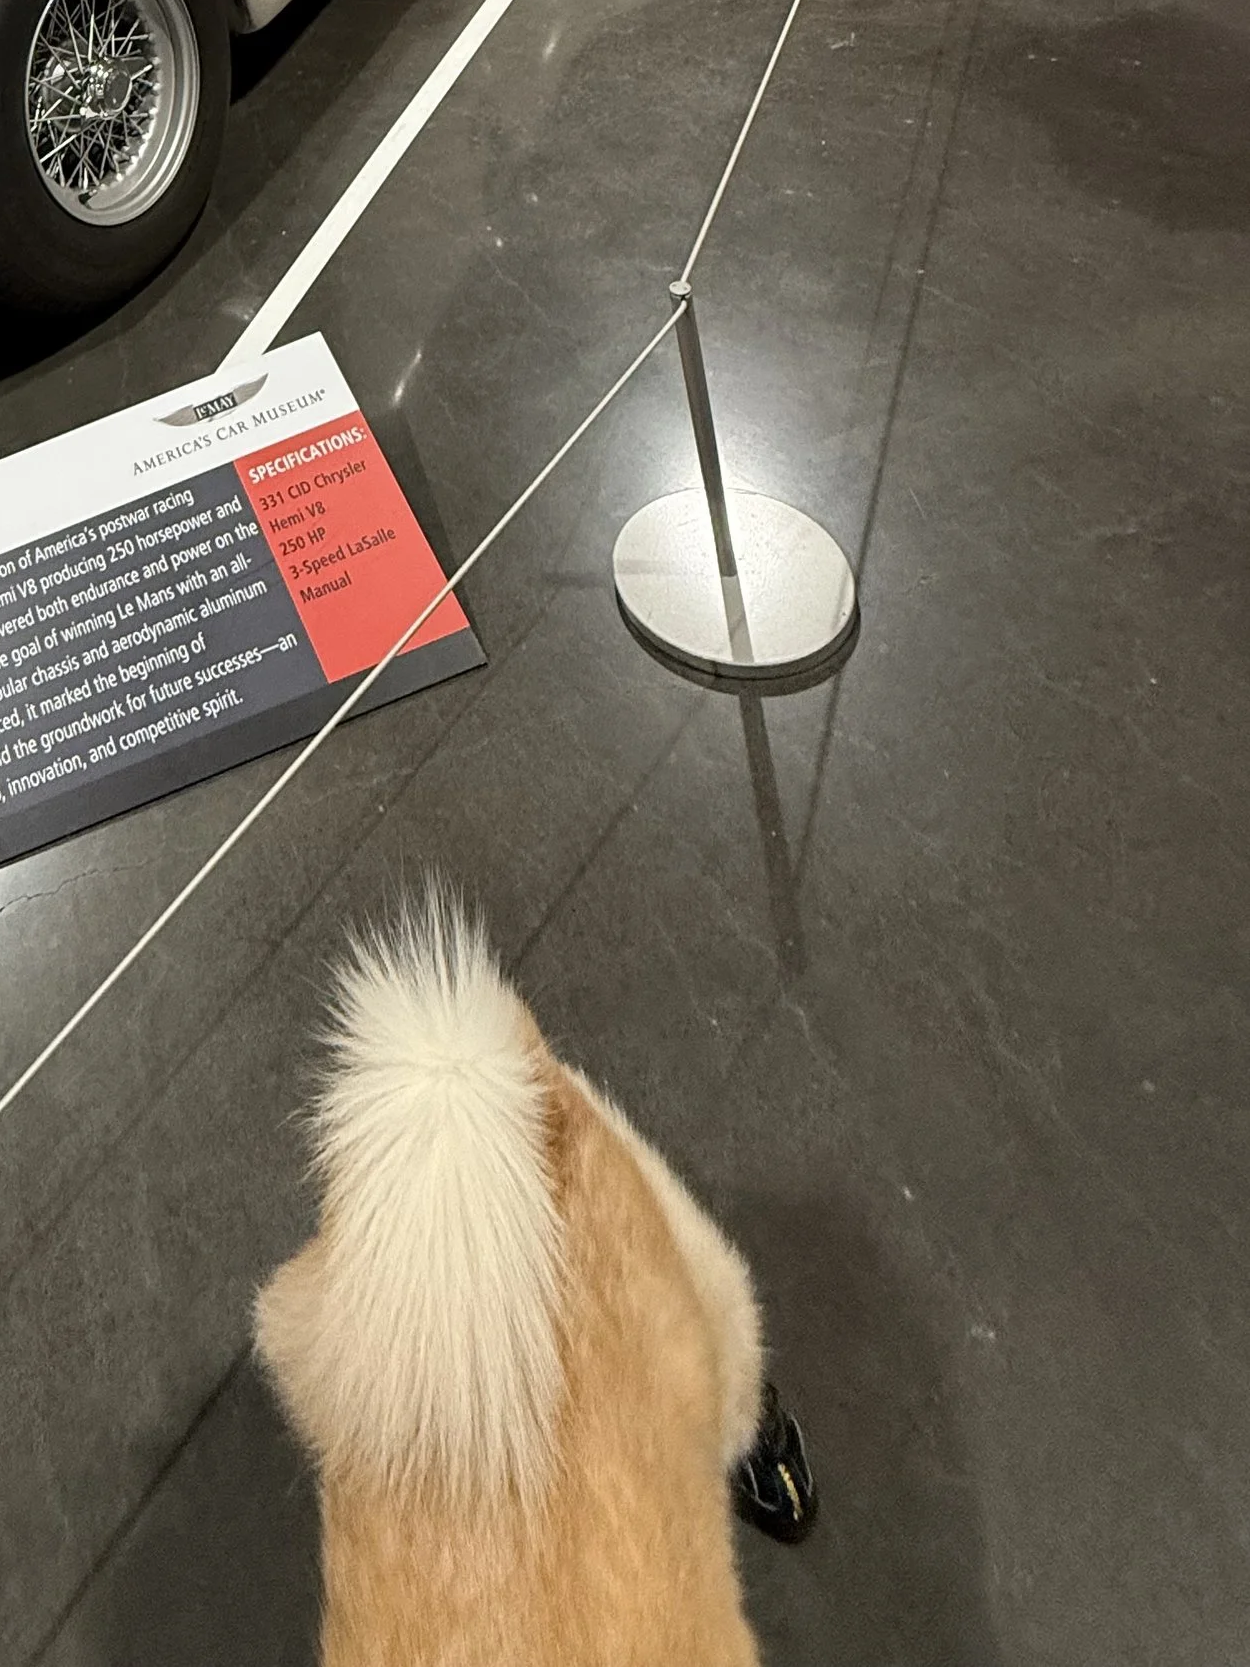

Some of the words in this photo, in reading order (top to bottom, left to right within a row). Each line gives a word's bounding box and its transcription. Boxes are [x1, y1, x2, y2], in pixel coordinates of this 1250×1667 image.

[133, 433, 212, 476] AMERICA'S
[215, 420, 249, 441] CAR
[247, 426, 367, 484] SPECIFICATIONS:
[258, 490, 285, 511] 331
[286, 480, 311, 499] CID
[312, 459, 366, 488] Chrysler
[17, 548, 32, 570] of
[34, 525, 97, 564] America's
[97, 505, 150, 541] postwar
[151, 489, 194, 515] racing
[267, 507, 305, 534] Hemi
[304, 500, 326, 518] V8
[277, 534, 306, 556] 250
[305, 526, 326, 545] HP
[15, 577, 38, 598] V8
[38, 553, 107, 594] producing
[105, 538, 135, 563] 250
[134, 509, 213, 551] horsepower
[214, 493, 242, 519] and
[287, 544, 346, 580] 3-Speed
[345, 527, 396, 556] LaSalle
[299, 569, 352, 604] Manual
[5, 754, 87, 797] innovation,
[87, 734, 117, 763] and
[118, 706, 201, 750] competitive
[201, 687, 243, 719] spirit.
[12, 738, 38, 759] the
[39, 699, 126, 753] groundwork
[125, 692, 147, 713] for
[148, 675, 193, 704] future
